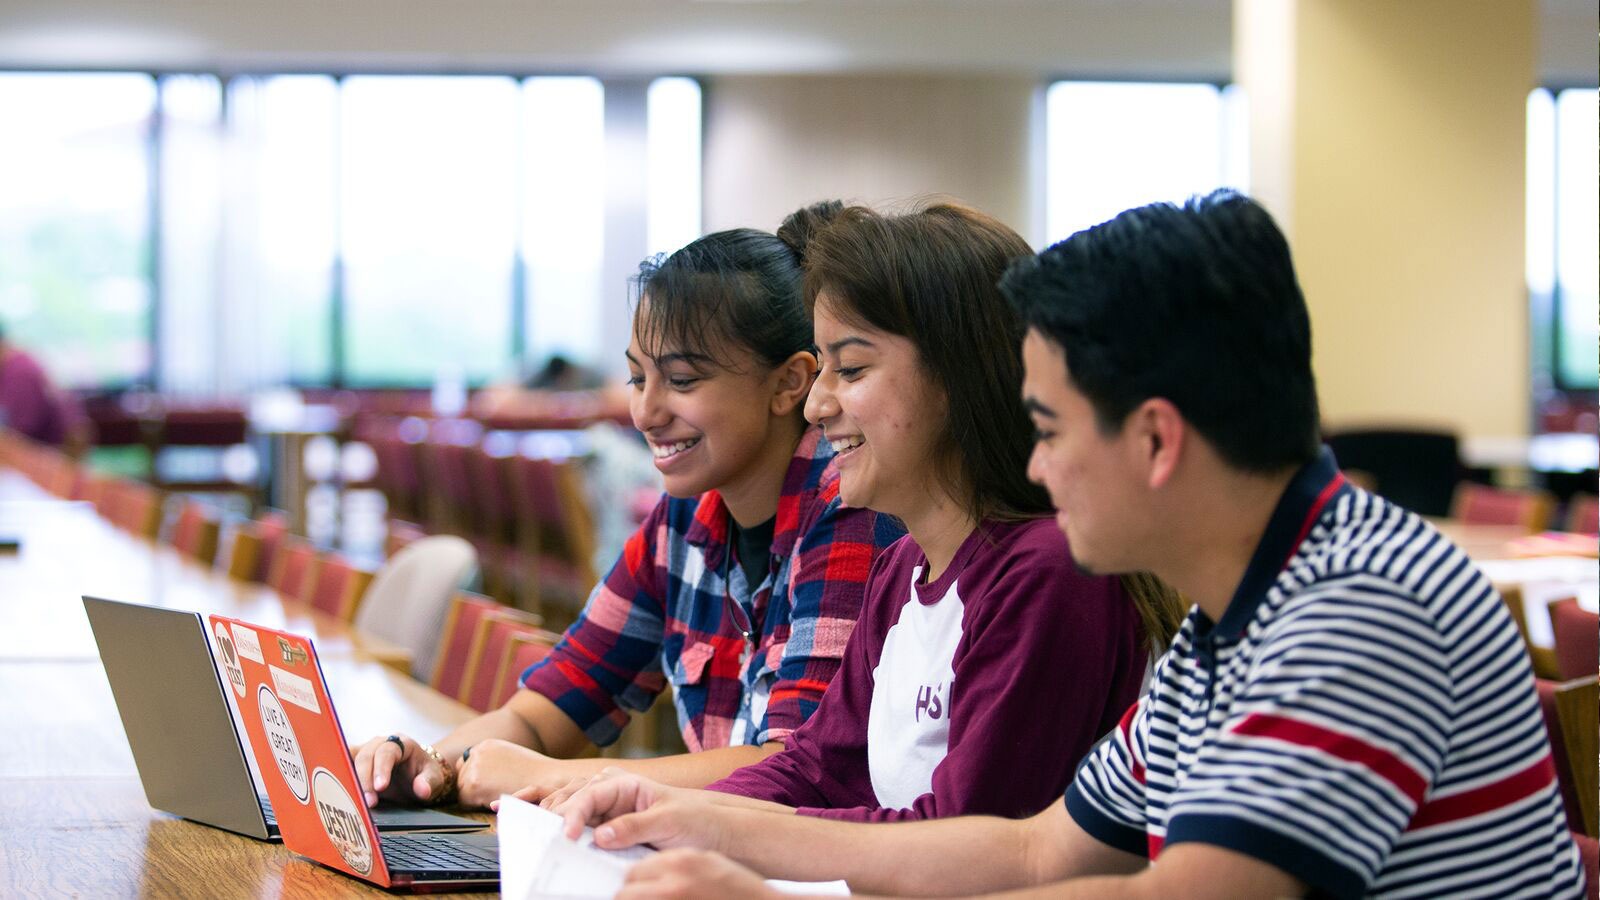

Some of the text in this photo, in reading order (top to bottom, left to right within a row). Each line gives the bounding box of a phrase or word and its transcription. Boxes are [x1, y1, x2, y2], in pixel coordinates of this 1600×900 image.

[263, 705, 288, 730] LIVE A
[271, 731, 296, 756] GREAT
[279, 758, 304, 783] STORY
[318, 800, 367, 849] DESTIN
